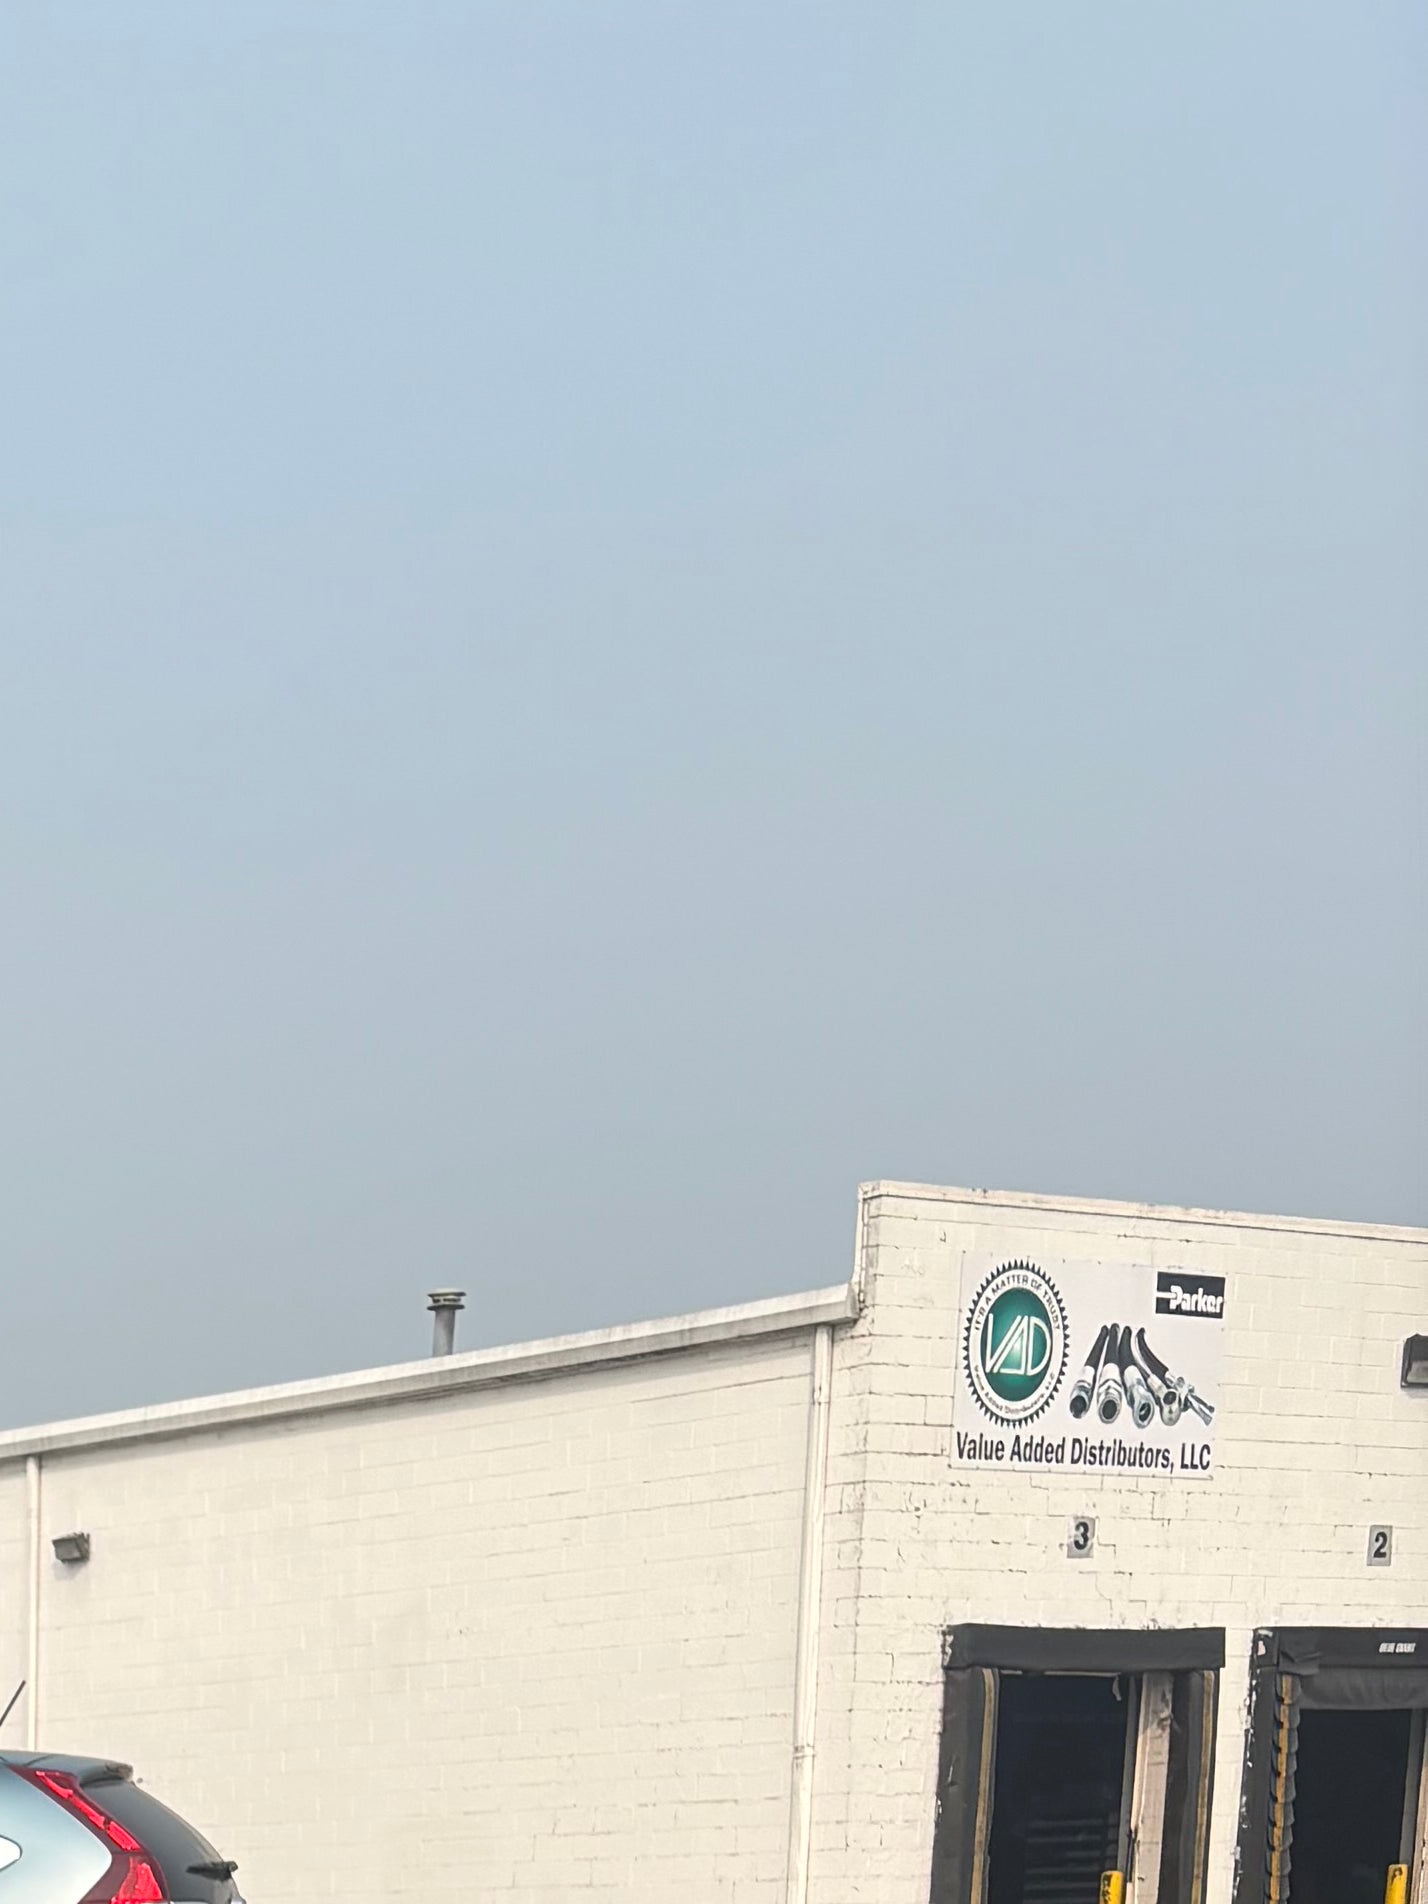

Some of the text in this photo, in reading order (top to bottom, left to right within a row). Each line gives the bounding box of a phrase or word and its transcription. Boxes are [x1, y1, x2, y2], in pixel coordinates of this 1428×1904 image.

[1169, 1285, 1223, 1313] Parker
[956, 1431, 1211, 1474] Value Added Distributors, LLC
[1074, 1521, 1090, 1551] 3
[1373, 1530, 1388, 1559] 2
